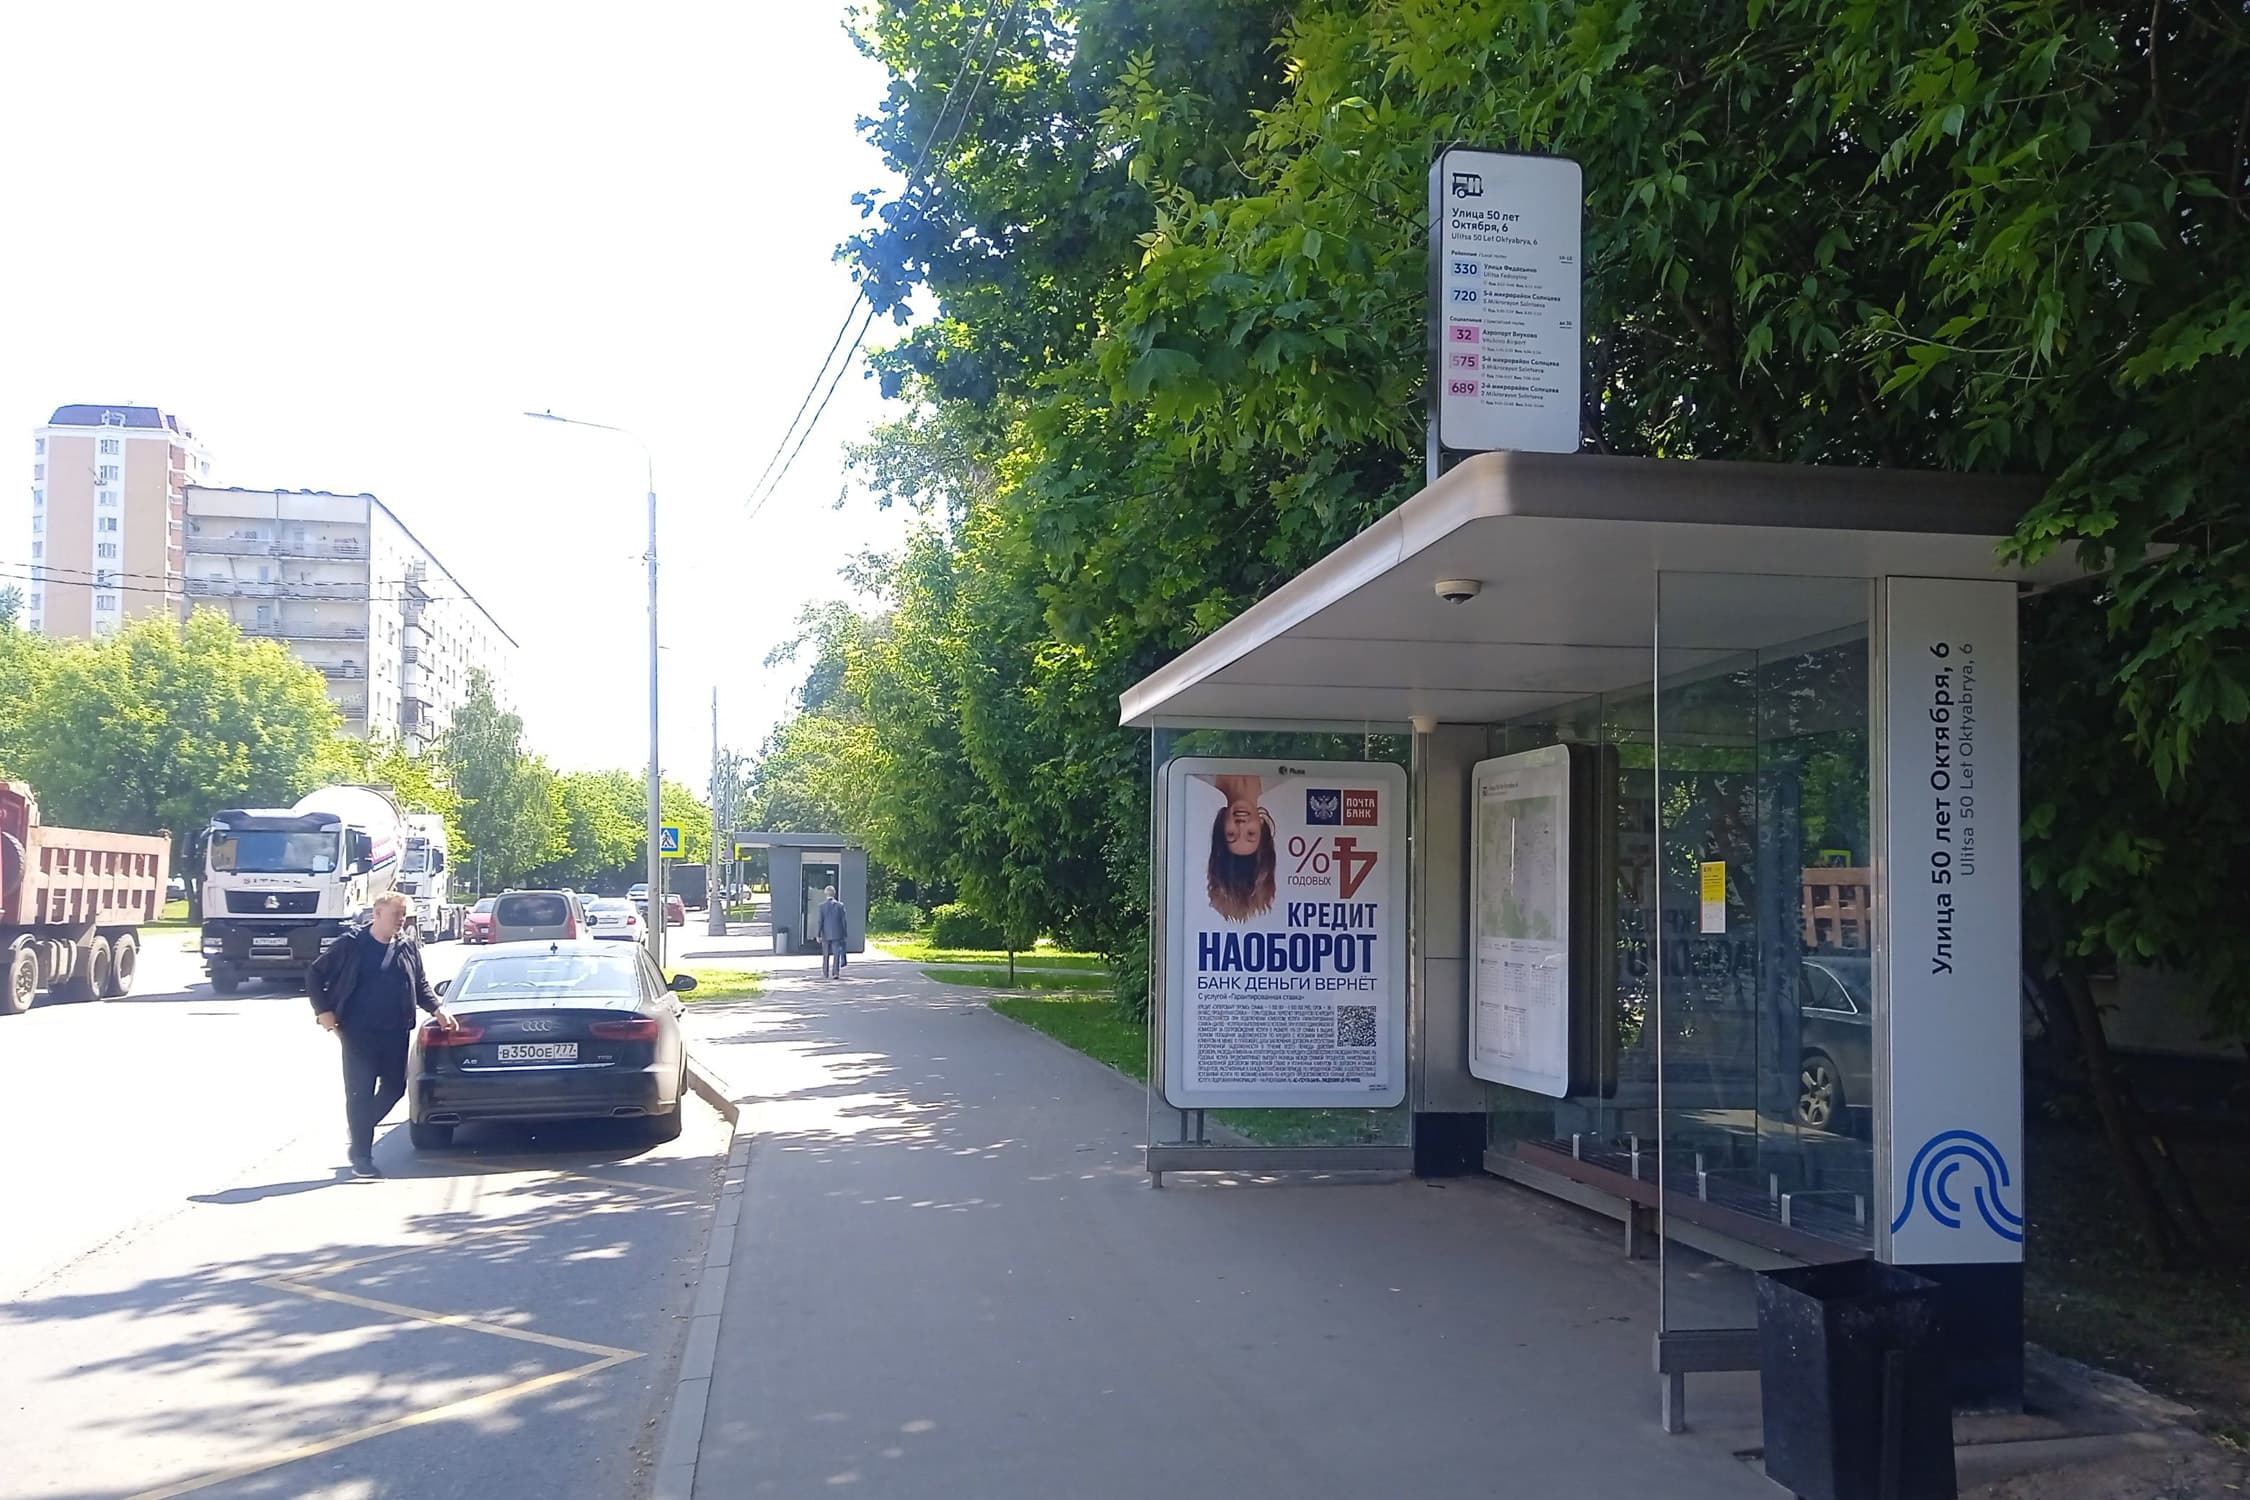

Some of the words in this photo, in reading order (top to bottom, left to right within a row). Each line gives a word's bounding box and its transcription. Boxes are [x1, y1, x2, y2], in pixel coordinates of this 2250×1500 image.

[1452, 208, 1484, 220] Улица
[1487, 210, 1500, 220] 50
[1502, 213, 1520, 222] лет
[1452, 219, 1499, 233] Октября,
[1502, 223, 1509, 232] 6
[1452, 233, 1471, 241] Ulitsa
[1454, 263, 1478, 275] 330
[1453, 290, 1477, 302] 720
[1457, 329, 1472, 340] 32
[1452, 355, 1476, 367] 575
[1451, 383, 1475, 394] 689
[1930, 641, 1950, 658] 6
[1960, 643, 1973, 654] 6
[1958, 661, 1976, 757] Oktyabrya,
[1930, 666, 1955, 790] Октября,
[1960, 761, 1975, 789] Let
[1347, 798, 1375, 808] ПОЧТА
[1961, 795, 1975, 819] 50
[1347, 808, 1371, 818] БАНК
[1936, 797, 1952, 843] лет
[1960, 826, 1975, 876] Ulitsa
[1931, 851, 1952, 884] 50
[1288, 902, 1378, 931] КРЕДИТ
[1932, 893, 1955, 975] Улица
[1199, 932, 1377, 973] НАОБОРОТ
[1198, 977, 1241, 990] БАНК
[1244, 977, 1310, 992] ДЕНЬГИ
[1316, 976, 1377, 991] ВЕРНЁТ
